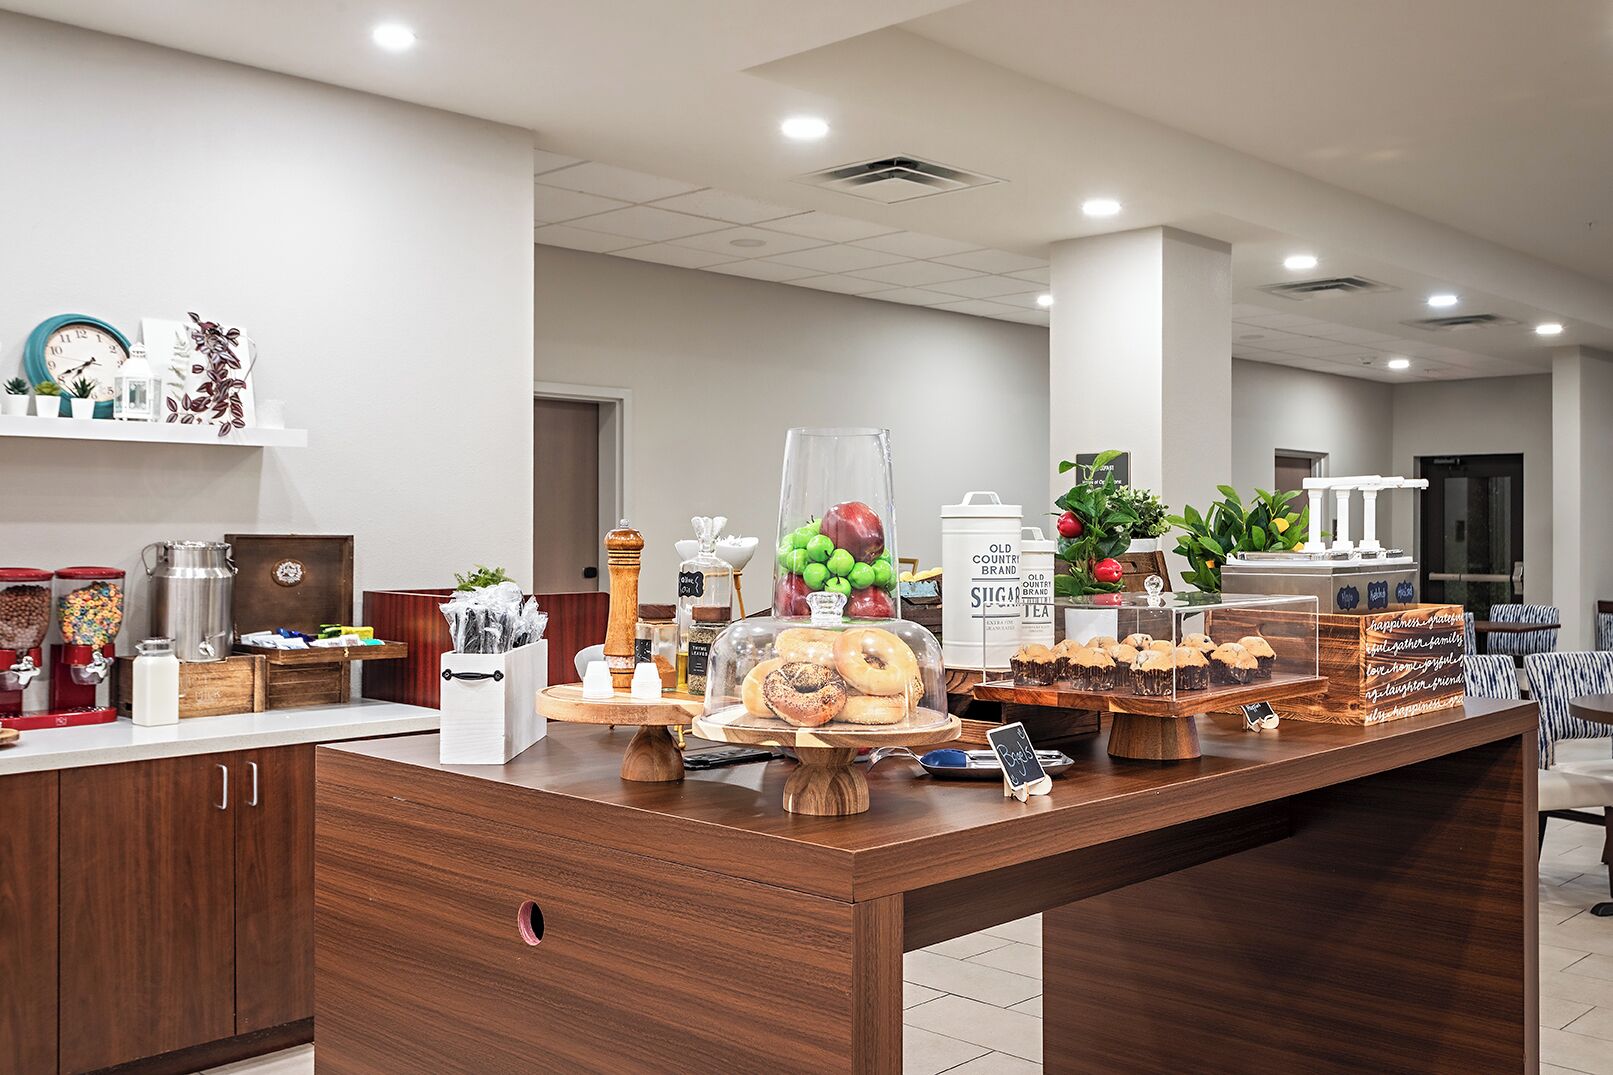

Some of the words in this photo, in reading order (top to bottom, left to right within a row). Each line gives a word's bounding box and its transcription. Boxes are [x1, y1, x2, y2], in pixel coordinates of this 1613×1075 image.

[60, 334, 71, 343] 11
[75, 329, 88, 339] 12
[96, 334, 102, 343] 1
[50, 346, 63, 356] 10
[109, 345, 117, 354] 2
[47, 360, 56, 370] 9
[107, 386, 114, 395] 5
[989, 543, 1012, 553] OLD
[981, 565, 1017, 575] BRAND
[1028, 573, 1045, 581] OLD
[971, 586, 1020, 608] SUGAR
[1022, 588, 1049, 596] BRAND
[1024, 603, 1049, 618] TEA
[1366, 617, 1420, 633] happiness
[1366, 664, 1387, 676] love
[996, 741, 1034, 777] Bagels
